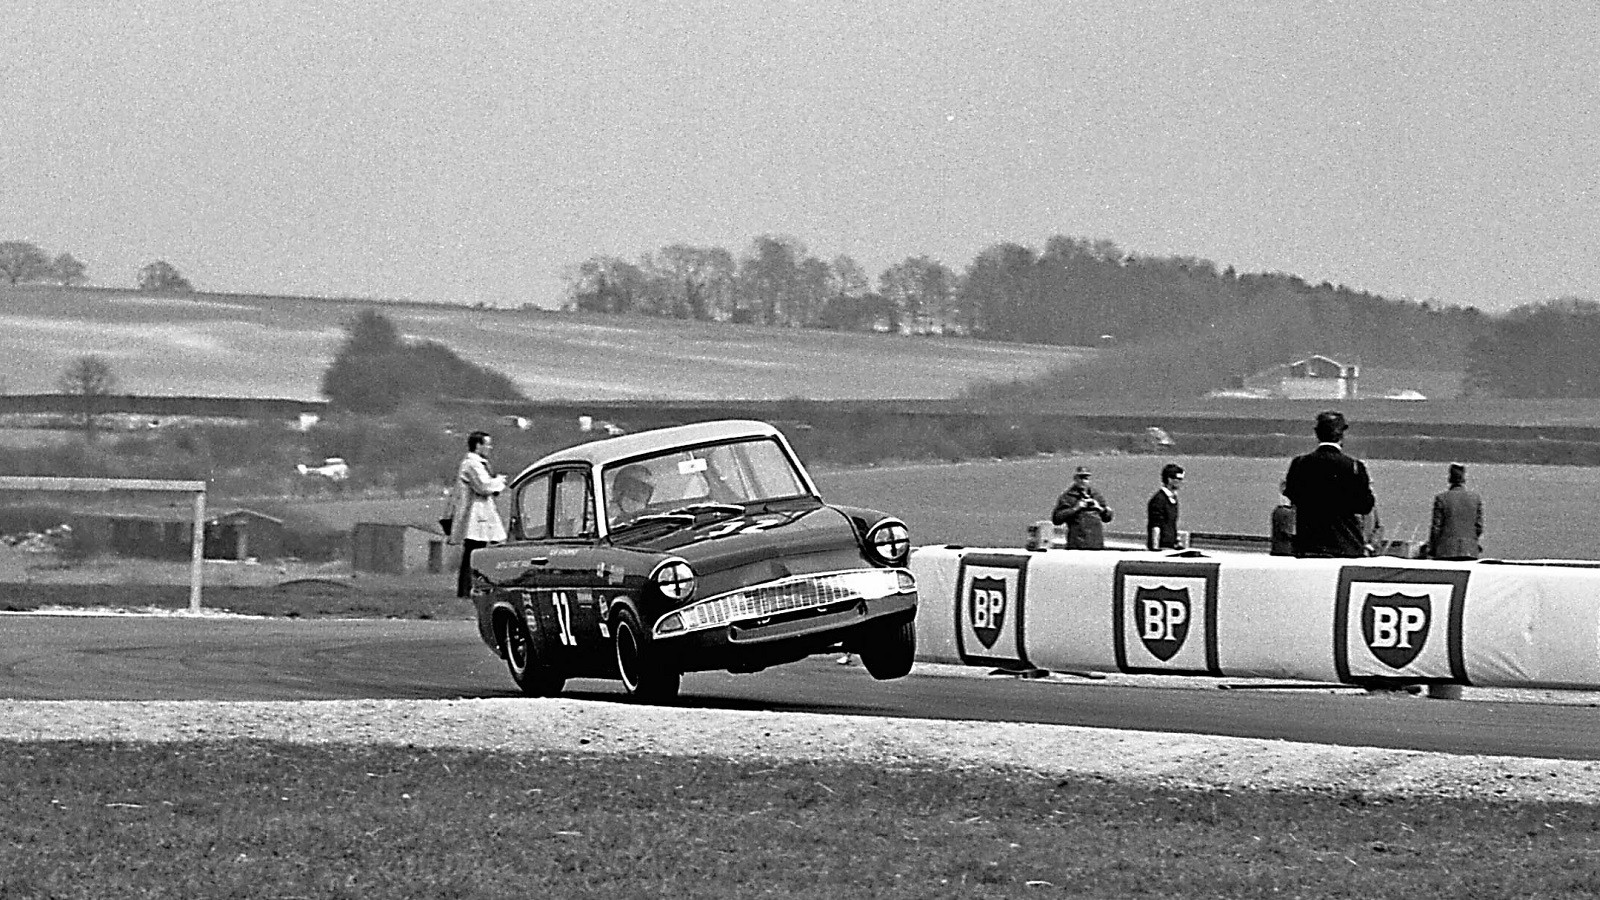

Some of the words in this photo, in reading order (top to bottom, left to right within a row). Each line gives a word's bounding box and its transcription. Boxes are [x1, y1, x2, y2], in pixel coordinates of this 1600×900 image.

[974, 588, 1003, 629] BP
[1141, 599, 1186, 641] BP
[1370, 606, 1426, 649] BP
